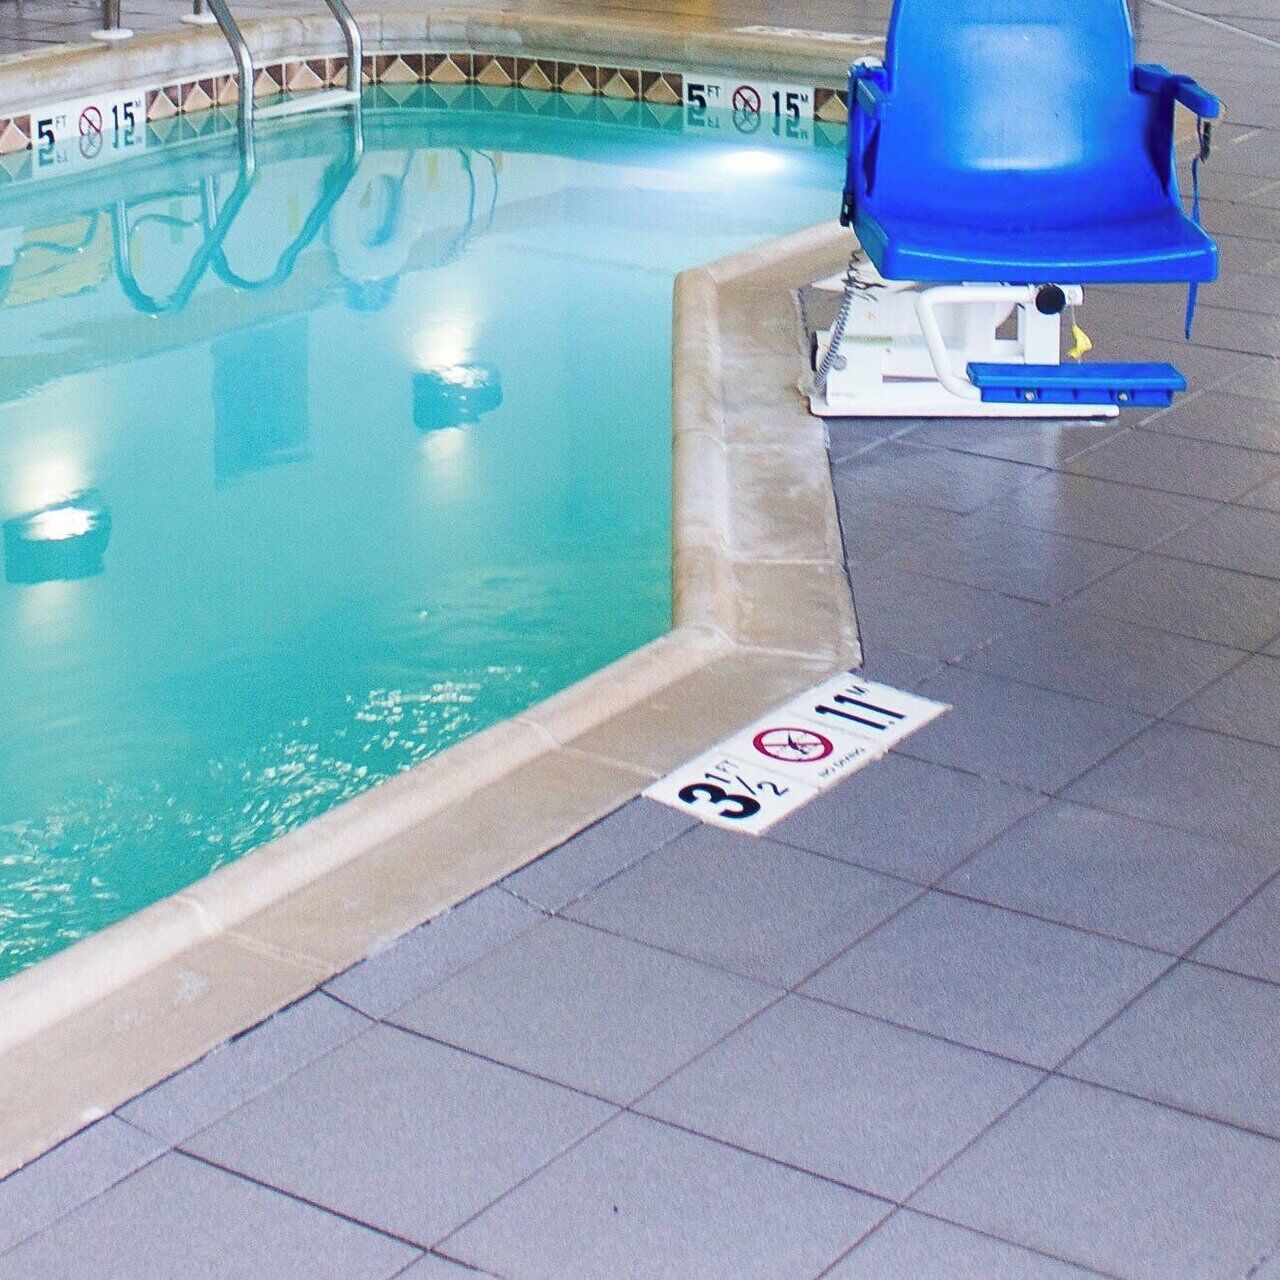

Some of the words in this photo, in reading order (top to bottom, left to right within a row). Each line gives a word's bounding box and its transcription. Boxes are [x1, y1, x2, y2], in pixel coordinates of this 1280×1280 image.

[687, 83, 707, 109] 5
[707, 85, 720, 98] FT
[38, 118, 55, 145] 5
[677, 783, 761, 819] 3
